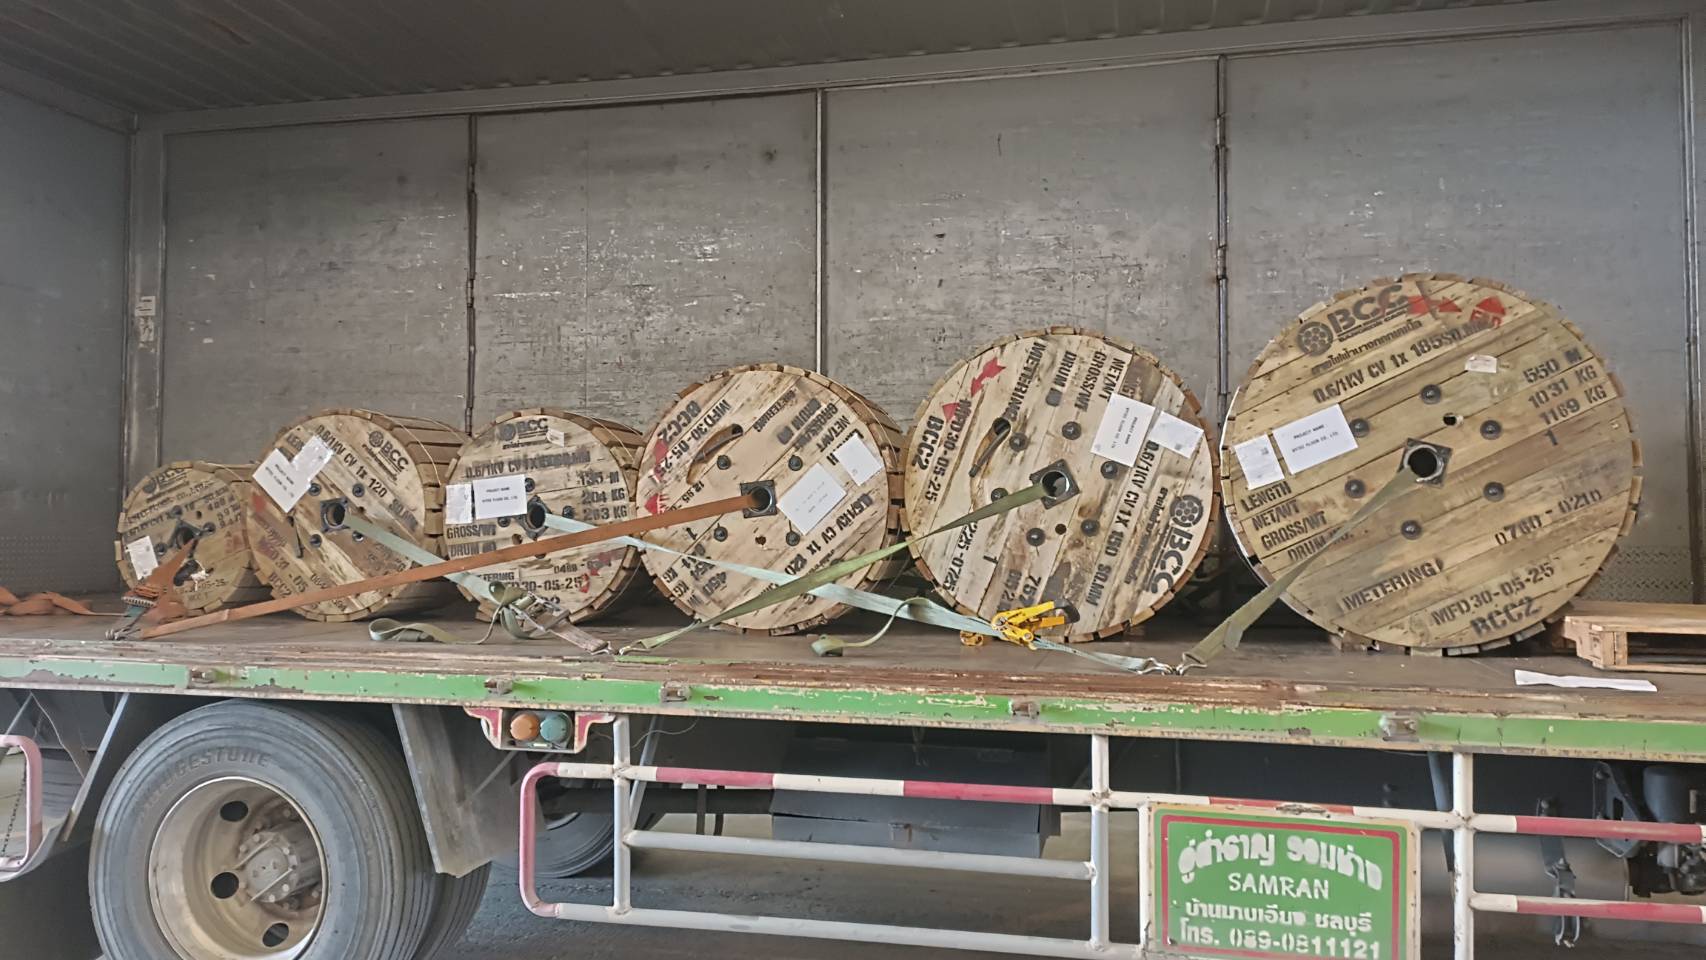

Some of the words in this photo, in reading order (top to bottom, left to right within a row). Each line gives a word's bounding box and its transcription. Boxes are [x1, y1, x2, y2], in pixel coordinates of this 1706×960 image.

[1326, 281, 1409, 334] BCC
[1052, 350, 1077, 388] DRUM
[1073, 349, 1107, 412] GROSS/WT
[1097, 357, 1125, 402] NET/WT
[1311, 369, 1366, 404] 0.6/1KV
[1365, 358, 1387, 379] CV
[1523, 359, 1560, 383] 550
[1528, 378, 1569, 408] 1031
[1575, 364, 1597, 383] KG
[1540, 398, 1580, 425] 1169
[1584, 385, 1607, 404] KG
[516, 418, 548, 432] BCC
[1545, 429, 1558, 446] 1
[379, 440, 410, 470] BCC
[910, 414, 945, 471] BCC2
[342, 453, 357, 468] CV
[365, 476, 388, 498] 120
[1130, 439, 1160, 488] 0.6/1KV
[610, 487, 625, 500] KG
[1122, 490, 1139, 507] CV
[1241, 481, 1292, 512] LENGTH
[612, 505, 627, 517] KG
[1251, 500, 1300, 531] NET/WT
[684, 525, 699, 540] 1
[819, 525, 837, 544] CV
[1261, 510, 1327, 551] GROSS/WT
[661, 567, 678, 584] KG
[1149, 527, 1193, 599] BCC
[265, 571, 294, 599] BCC2
[672, 580, 689, 597] KG
[1470, 597, 1542, 637] BCC2
[1228, 872, 1328, 900] SAMRAN
[1180, 918, 1220, 946] โทร.
[1230, 928, 1380, 960] 089-0811121
